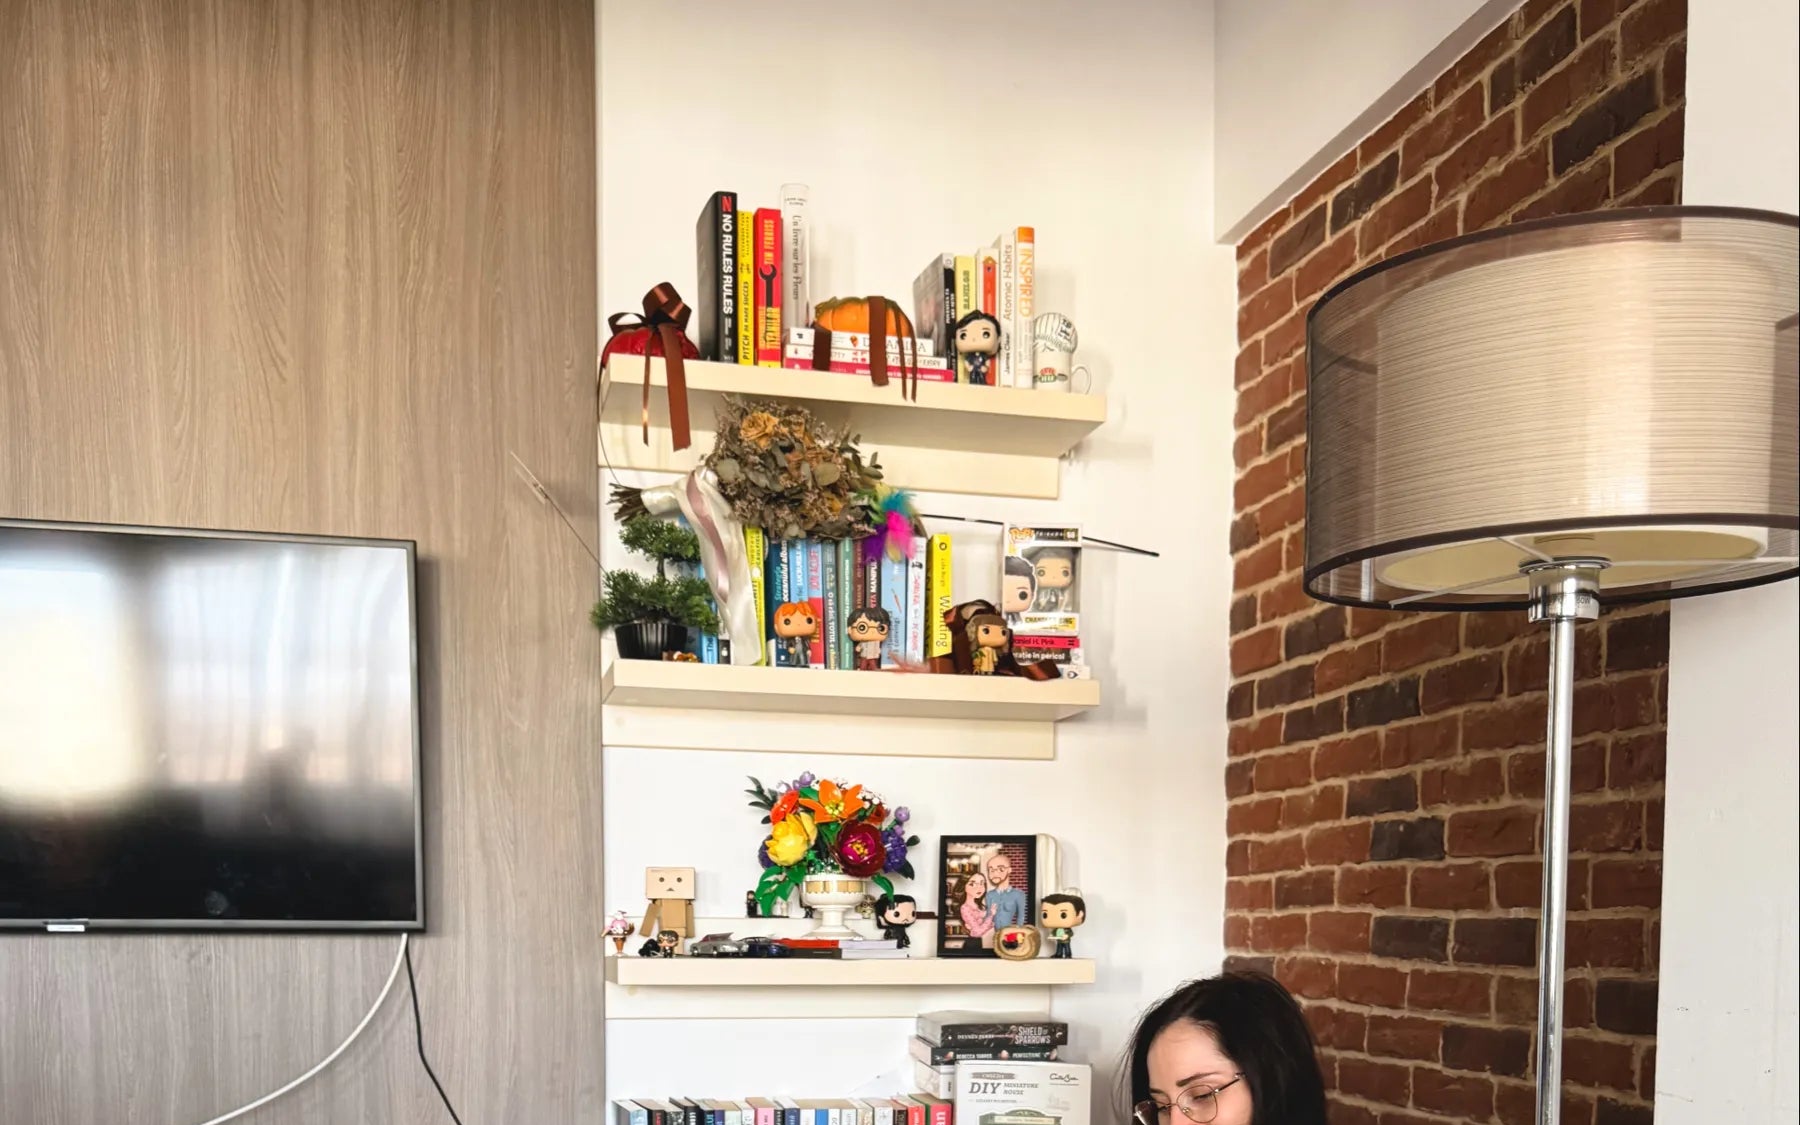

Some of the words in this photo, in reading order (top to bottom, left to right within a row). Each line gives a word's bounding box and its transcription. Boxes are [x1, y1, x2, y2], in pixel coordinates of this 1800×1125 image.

[722, 214, 733, 232] NO
[792, 215, 801, 226] Un
[764, 219, 775, 250] FERRISS
[792, 227, 802, 247] livre
[722, 234, 733, 276] RULES
[764, 251, 774, 265] TIM
[1003, 244, 1013, 279] Habits
[792, 262, 802, 275] les
[792, 276, 802, 300] Fleurs
[1020, 248, 1033, 318] INSPIRED
[722, 277, 733, 315] RULES
[1003, 282, 1012, 320] Atomic
[743, 335, 751, 360] PITCH
[781, 564, 789, 602] oceanului
[706, 638, 714, 652] The
[1013, 637, 1031, 645] aniel
[1041, 652, 1064, 661] pericol
[1014, 1035, 1051, 1044] SPARROWS
[1018, 1026, 1042, 1035] SHIELD
[969, 1082, 1001, 1094] DIY
